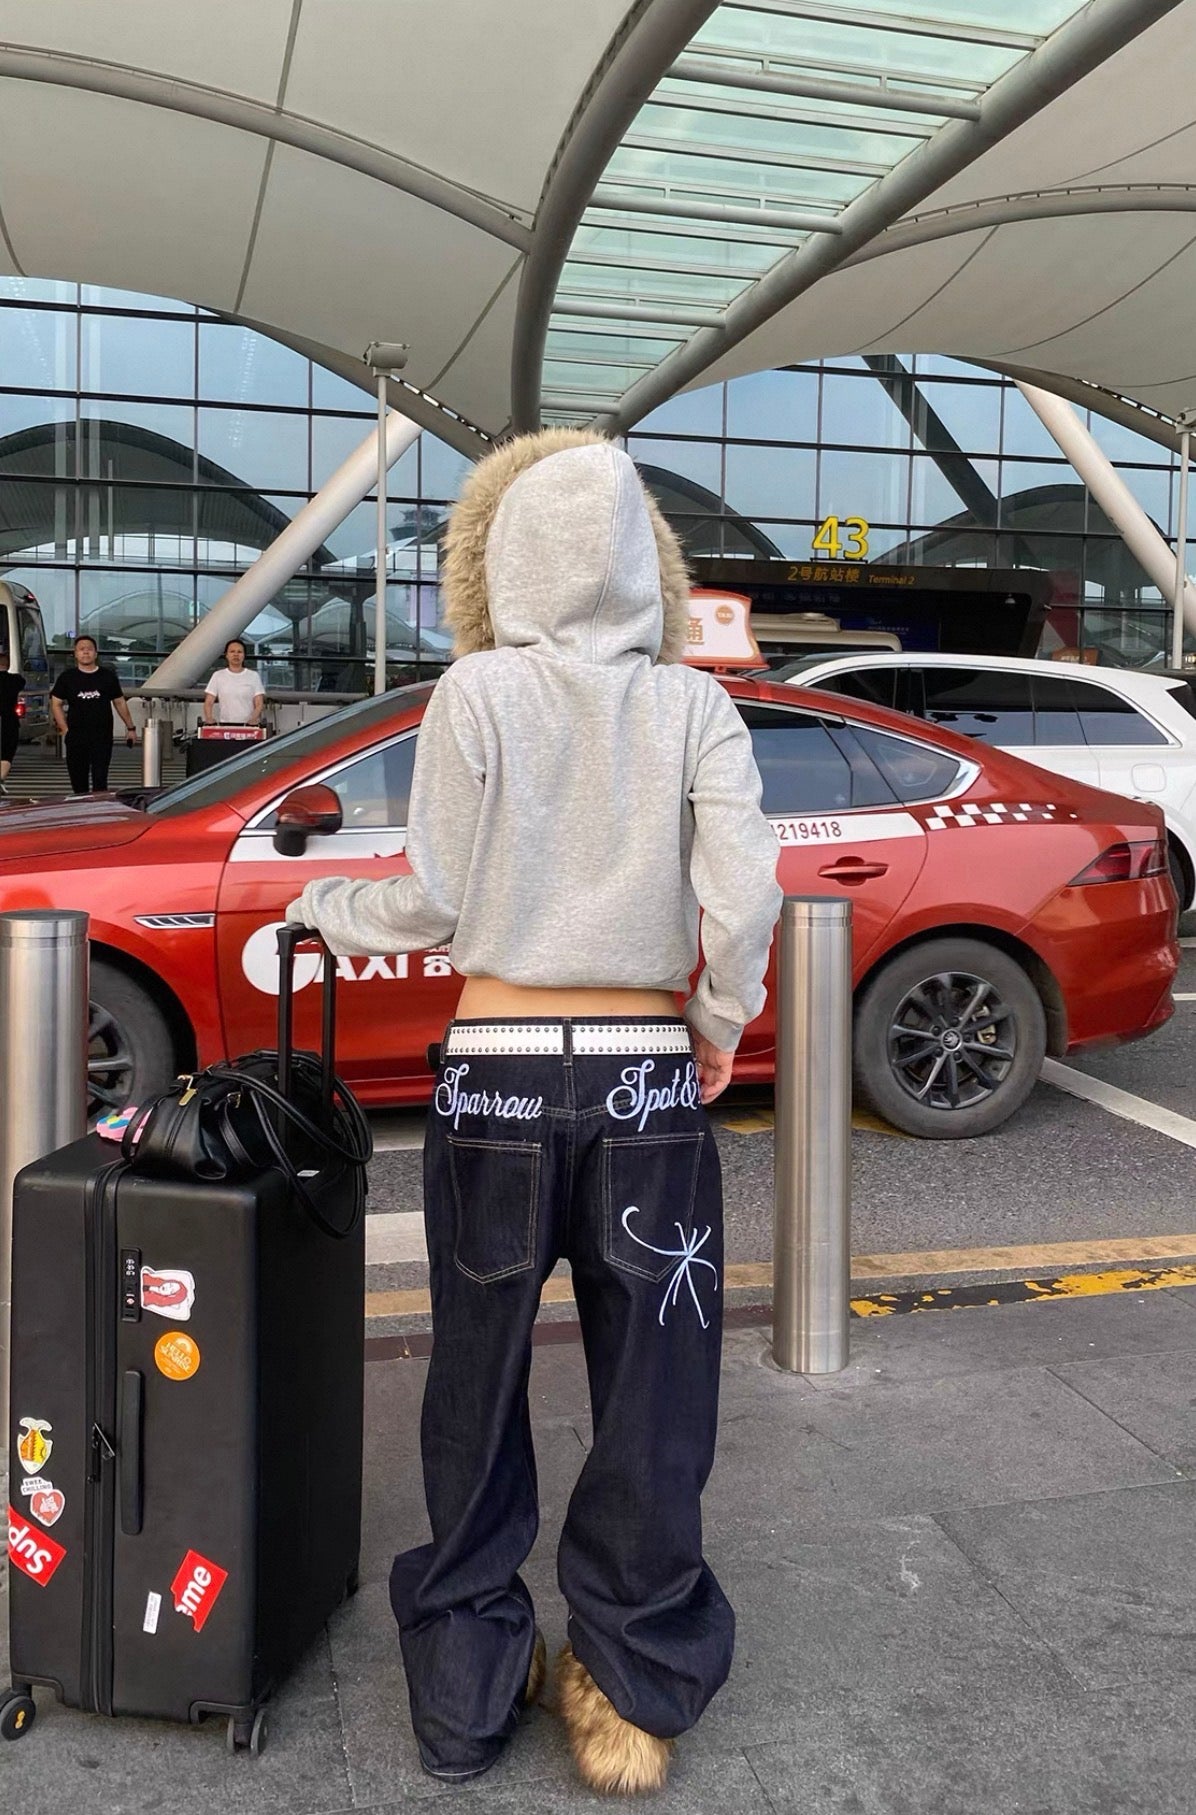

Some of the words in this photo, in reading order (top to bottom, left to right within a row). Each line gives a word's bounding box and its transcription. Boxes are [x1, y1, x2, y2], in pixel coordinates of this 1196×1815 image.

[811, 515, 870, 560] 43
[787, 566, 861, 583] 2号航站楼
[868, 575, 907, 585] Terminal
[907, 576, 916, 585] 2
[770, 821, 842, 840] 219418
[435, 1063, 543, 1131] Sparrow
